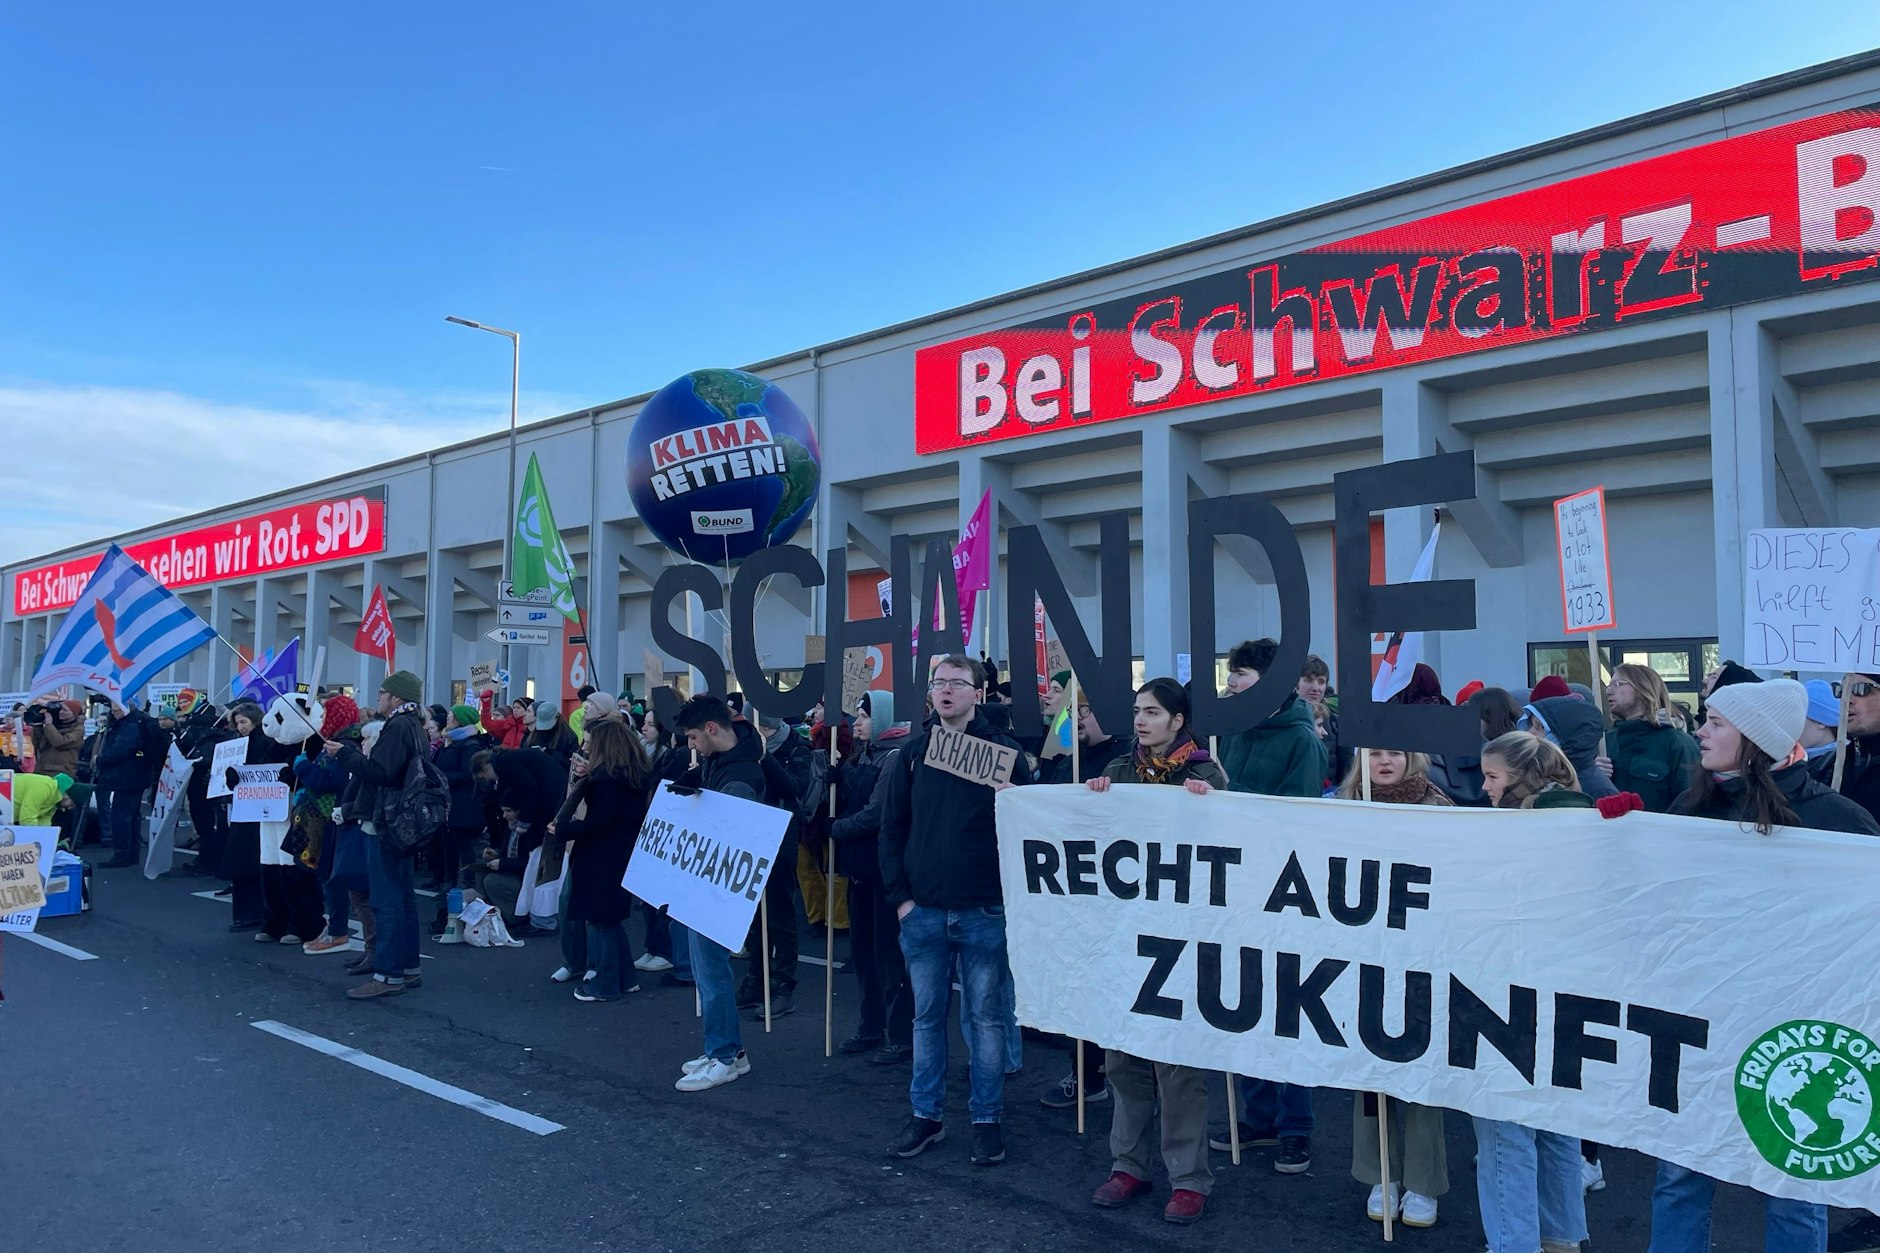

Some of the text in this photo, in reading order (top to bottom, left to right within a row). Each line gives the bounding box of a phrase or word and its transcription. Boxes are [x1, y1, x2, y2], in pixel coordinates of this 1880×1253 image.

[958, 312, 1096, 440] Bei
[654, 420, 768, 467] KLIMA
[650, 446, 786, 502] RETTEN!
[712, 517, 743, 526] BUND
[1572, 501, 1597, 521] beginning
[1575, 519, 1588, 537] look
[21, 571, 42, 611] Bei
[150, 538, 207, 585] sehen
[214, 524, 251, 575] wir
[258, 513, 309, 568] Rot.
[315, 497, 369, 556] SPD
[1565, 537, 1591, 558] a lot
[1574, 560, 1586, 574] like
[1749, 532, 1856, 573] DIESES
[650, 451, 1481, 756] SCHANDE
[1567, 591, 1606, 626] 1933
[1756, 580, 1834, 618] hilft
[570, 651, 585, 689] 6
[930, 728, 1009, 784] SCHANDE
[239, 771, 255, 783] WIR
[255, 770, 273, 782] SIND
[1, 867, 25, 881] HABEN
[14, 851, 35, 865] HASS
[636, 817, 770, 902] MERZ: SCHANDE
[1023, 838, 1432, 930] RECHT AUF
[0, 914, 32, 926] ALTER
[1130, 935, 1710, 1114] ZUKUNFT
[1740, 1025, 1880, 1091] FRIDAYS FOR
[1784, 1131, 1880, 1175] FUTURE
